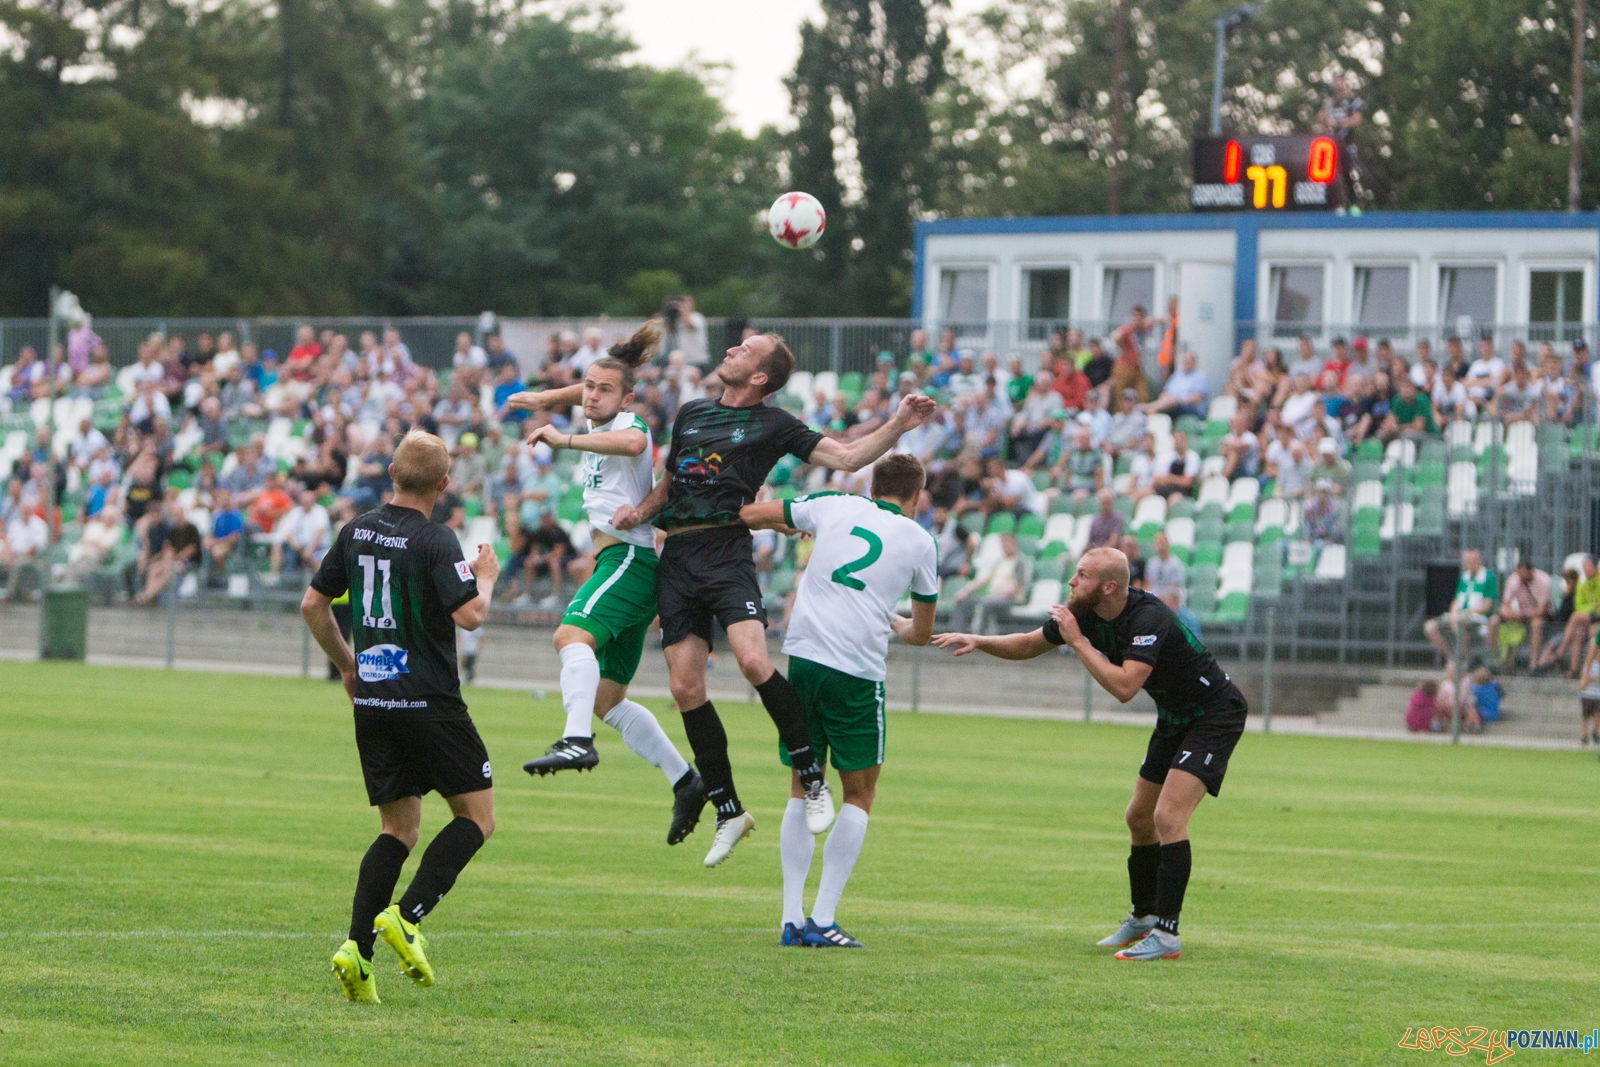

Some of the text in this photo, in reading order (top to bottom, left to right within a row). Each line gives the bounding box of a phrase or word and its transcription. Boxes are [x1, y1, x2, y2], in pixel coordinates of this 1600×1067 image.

[1308, 137, 1337, 183] 0
[353, 528, 375, 541] ROW
[831, 526, 883, 591] 2
[358, 555, 397, 629] 11
[745, 601, 757, 615] 5
[357, 649, 410, 674] OMALEX
[1178, 750, 1192, 764] 7
